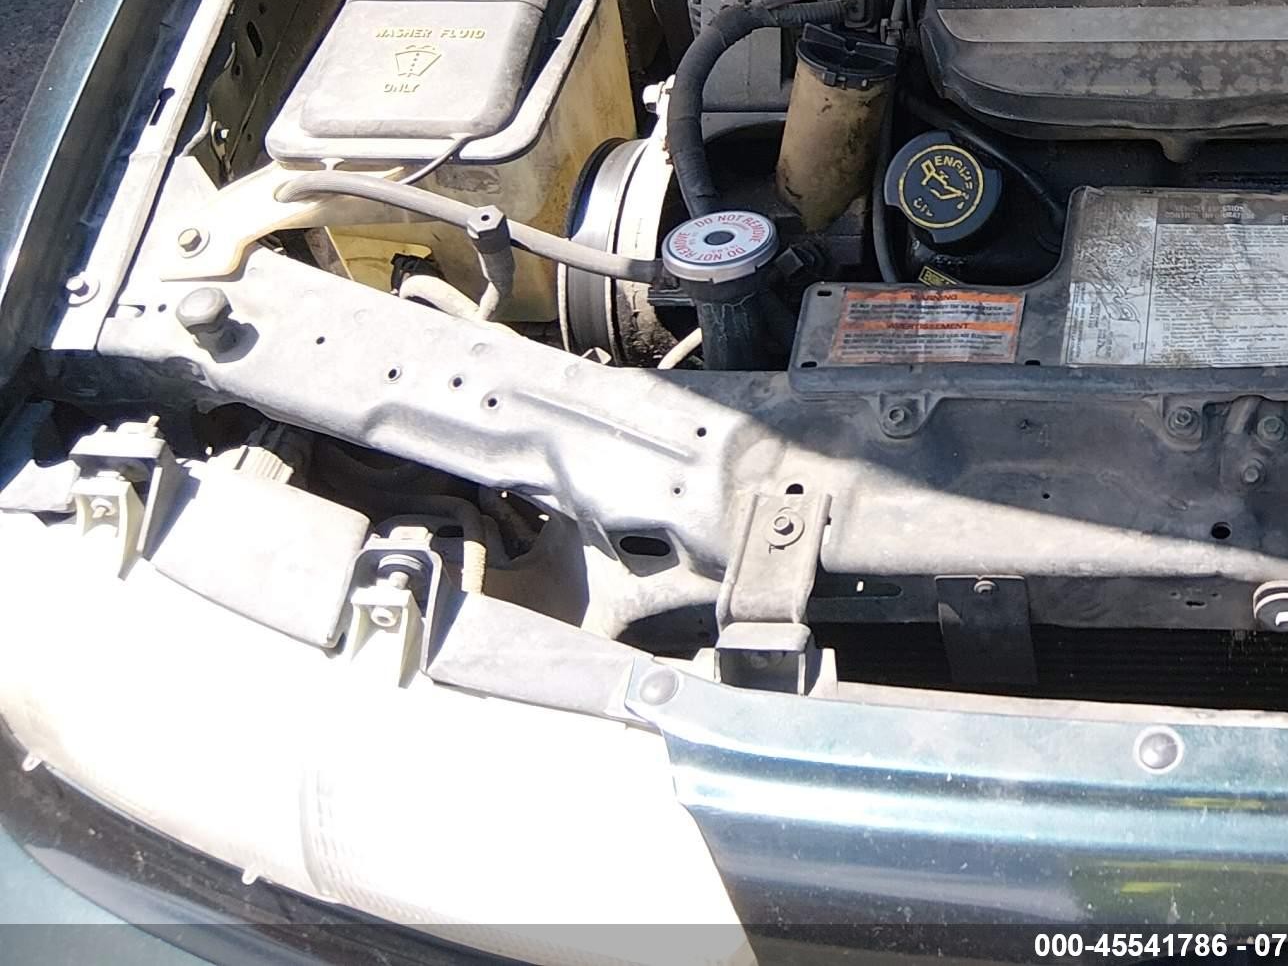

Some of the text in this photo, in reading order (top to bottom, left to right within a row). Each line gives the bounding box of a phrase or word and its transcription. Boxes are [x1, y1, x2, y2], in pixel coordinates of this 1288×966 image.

[376, 28, 486, 39] WASHER FLUID
[383, 83, 421, 93] ONLY
[934, 155, 974, 190] ENGINE
[695, 217, 713, 228] DO
[718, 214, 744, 222] NOT
[742, 217, 766, 243] REMOVE
[673, 232, 694, 259] REMOVE
[727, 246, 746, 258] DO
